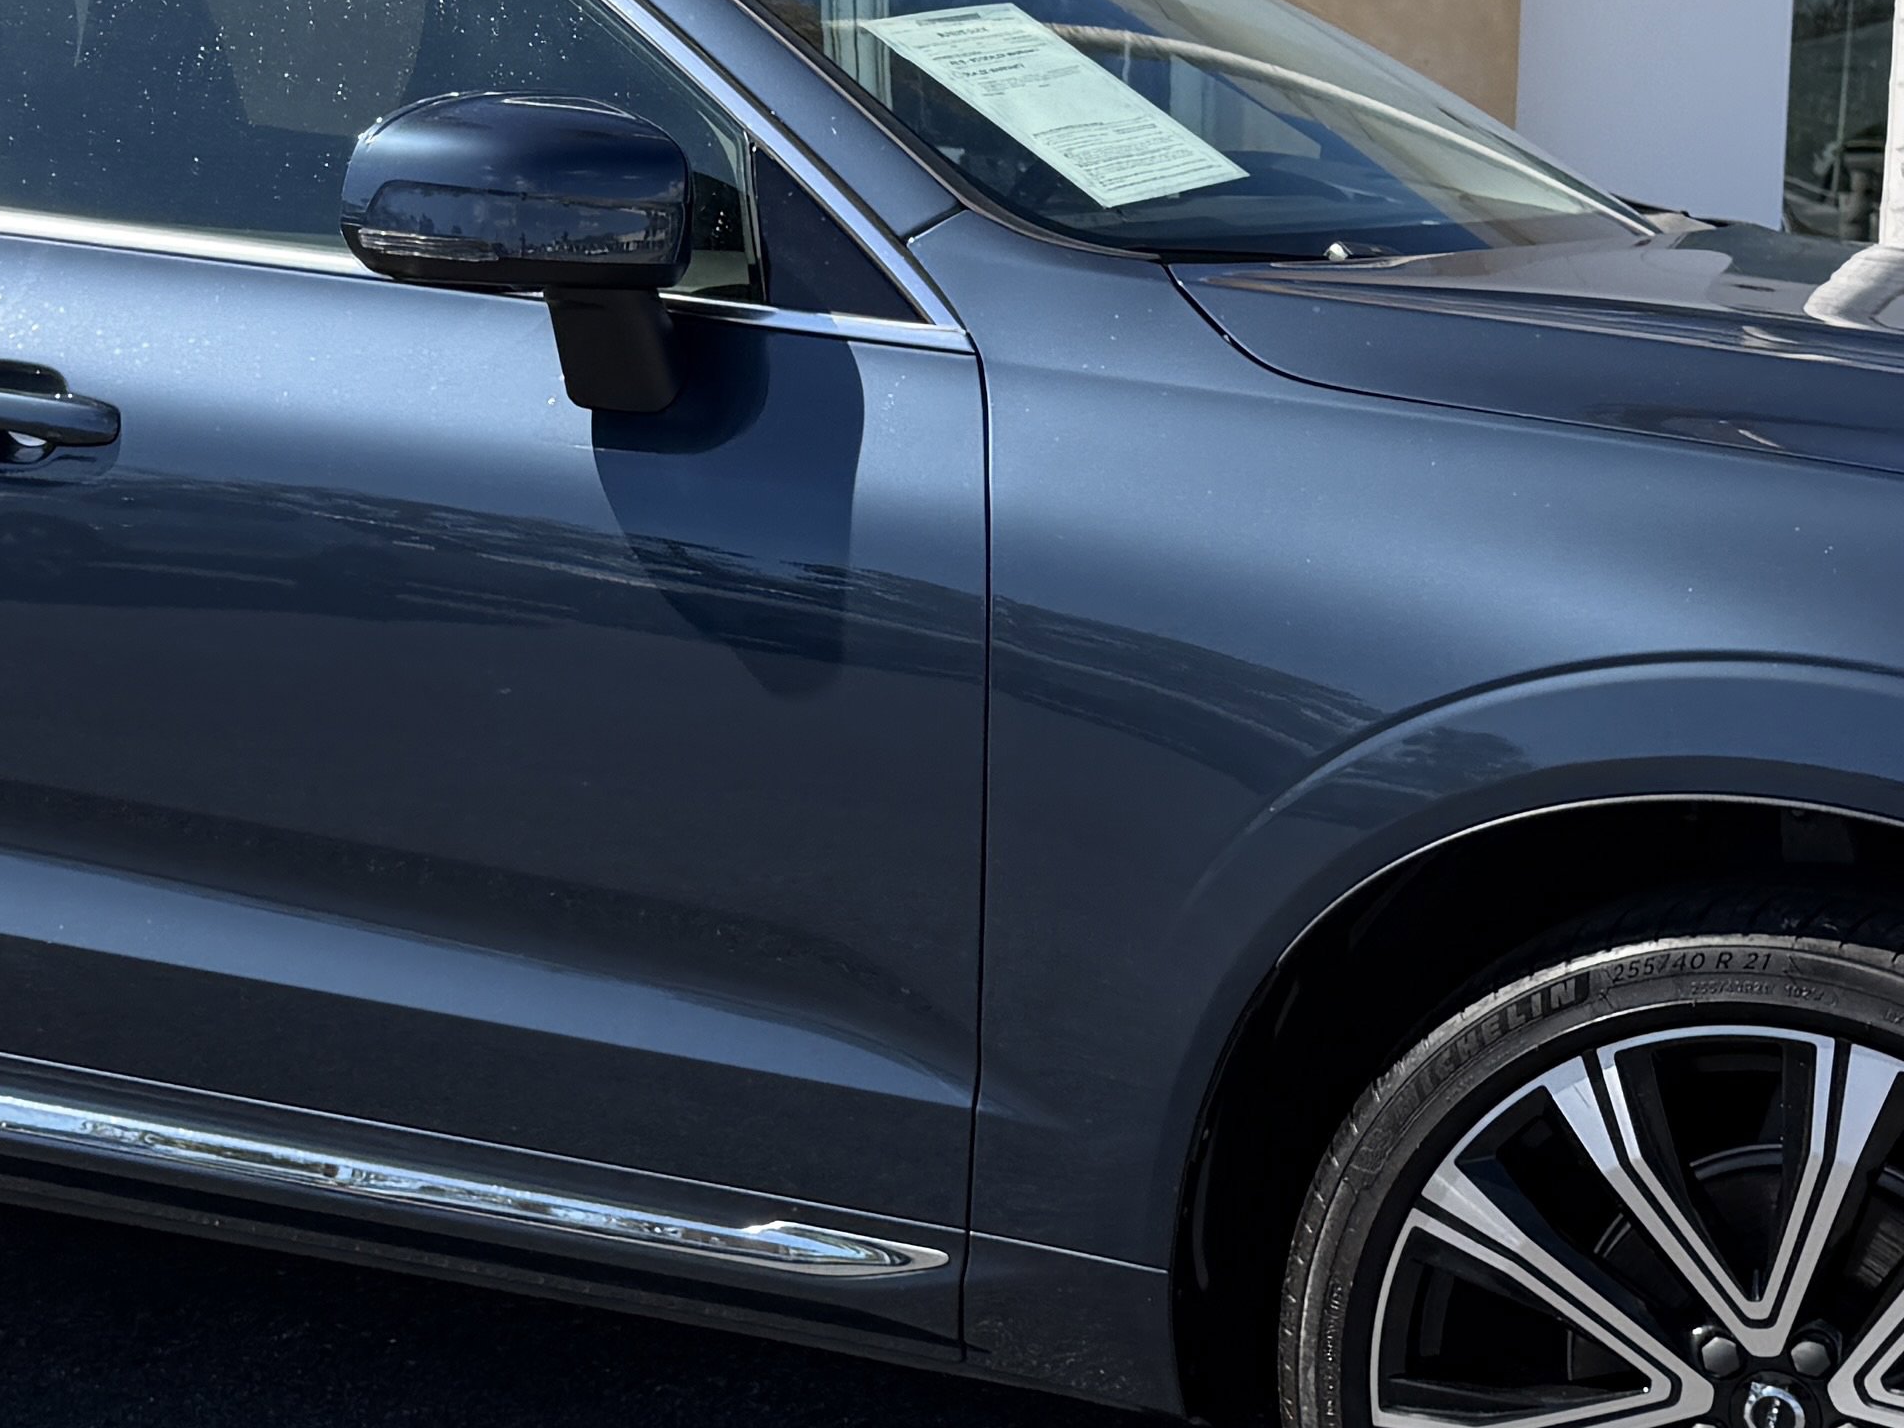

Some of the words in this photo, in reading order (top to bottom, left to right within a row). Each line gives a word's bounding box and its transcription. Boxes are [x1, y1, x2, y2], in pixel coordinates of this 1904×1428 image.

[1612, 952, 1706, 983] 255/40
[1715, 951, 1733, 970] R
[1742, 952, 1772, 971] 21
[1393, 978, 1576, 1115] MICHELIN
